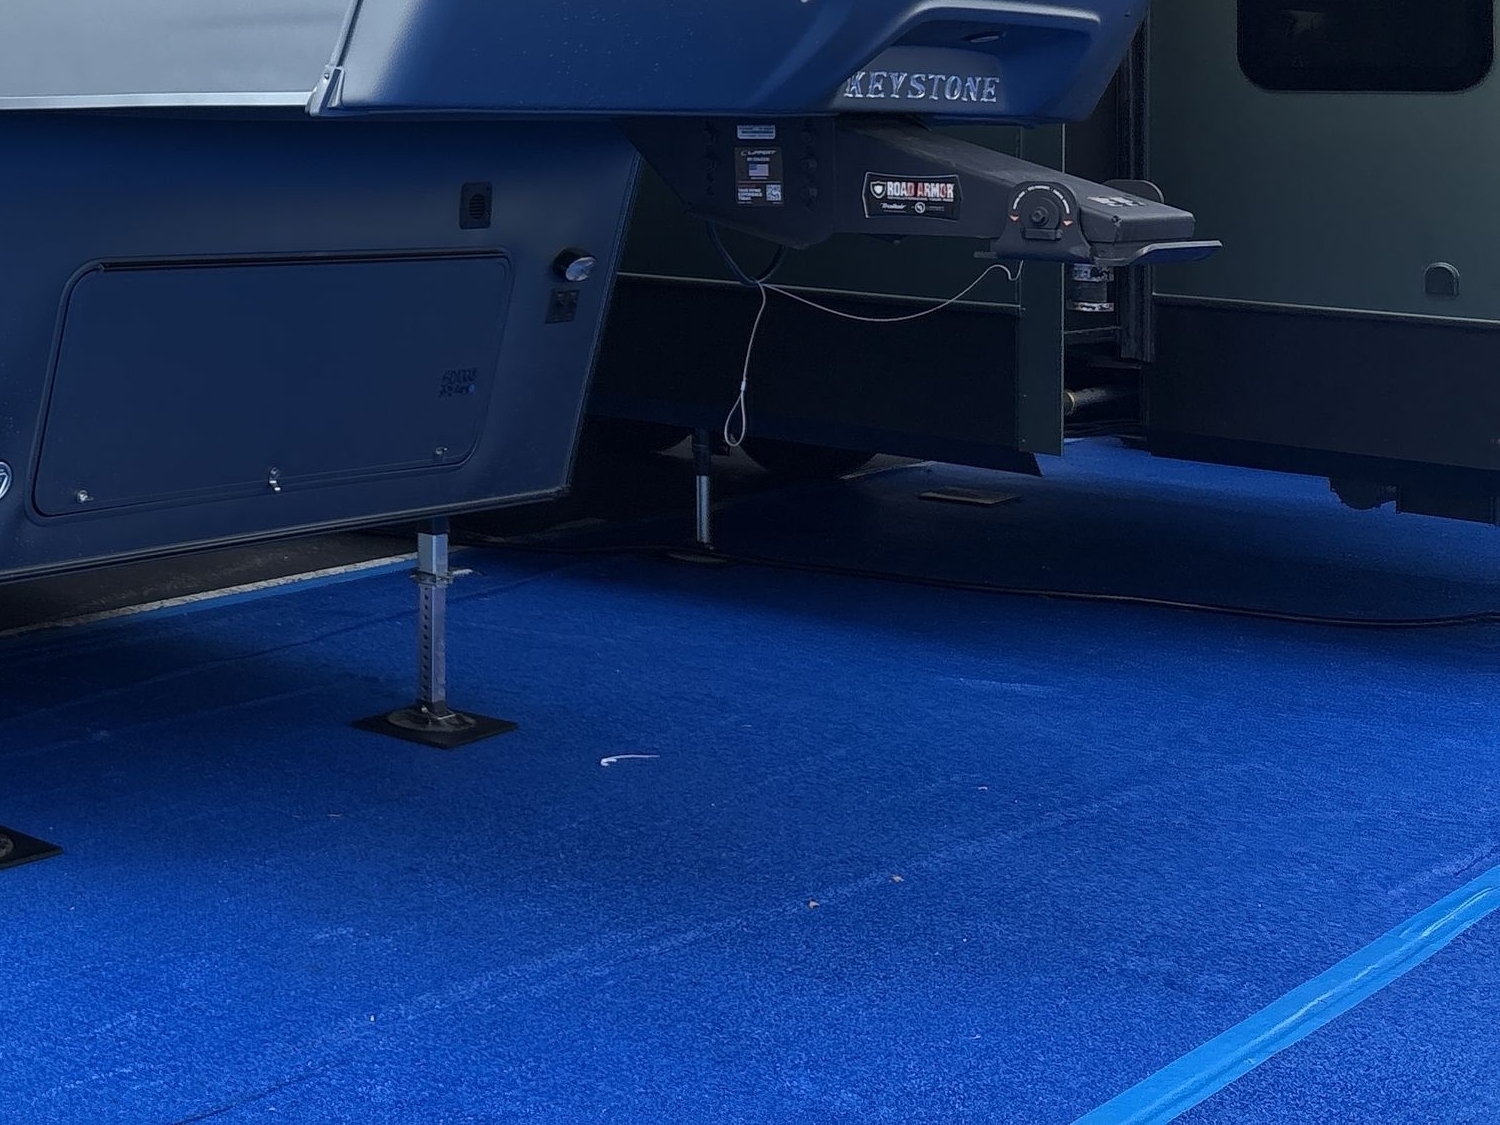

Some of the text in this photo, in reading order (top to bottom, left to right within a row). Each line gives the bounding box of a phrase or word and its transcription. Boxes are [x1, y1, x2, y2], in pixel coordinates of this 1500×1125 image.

[844, 71, 1000, 102] KEYSTONE
[887, 181, 955, 198] ROAD ARMOR
